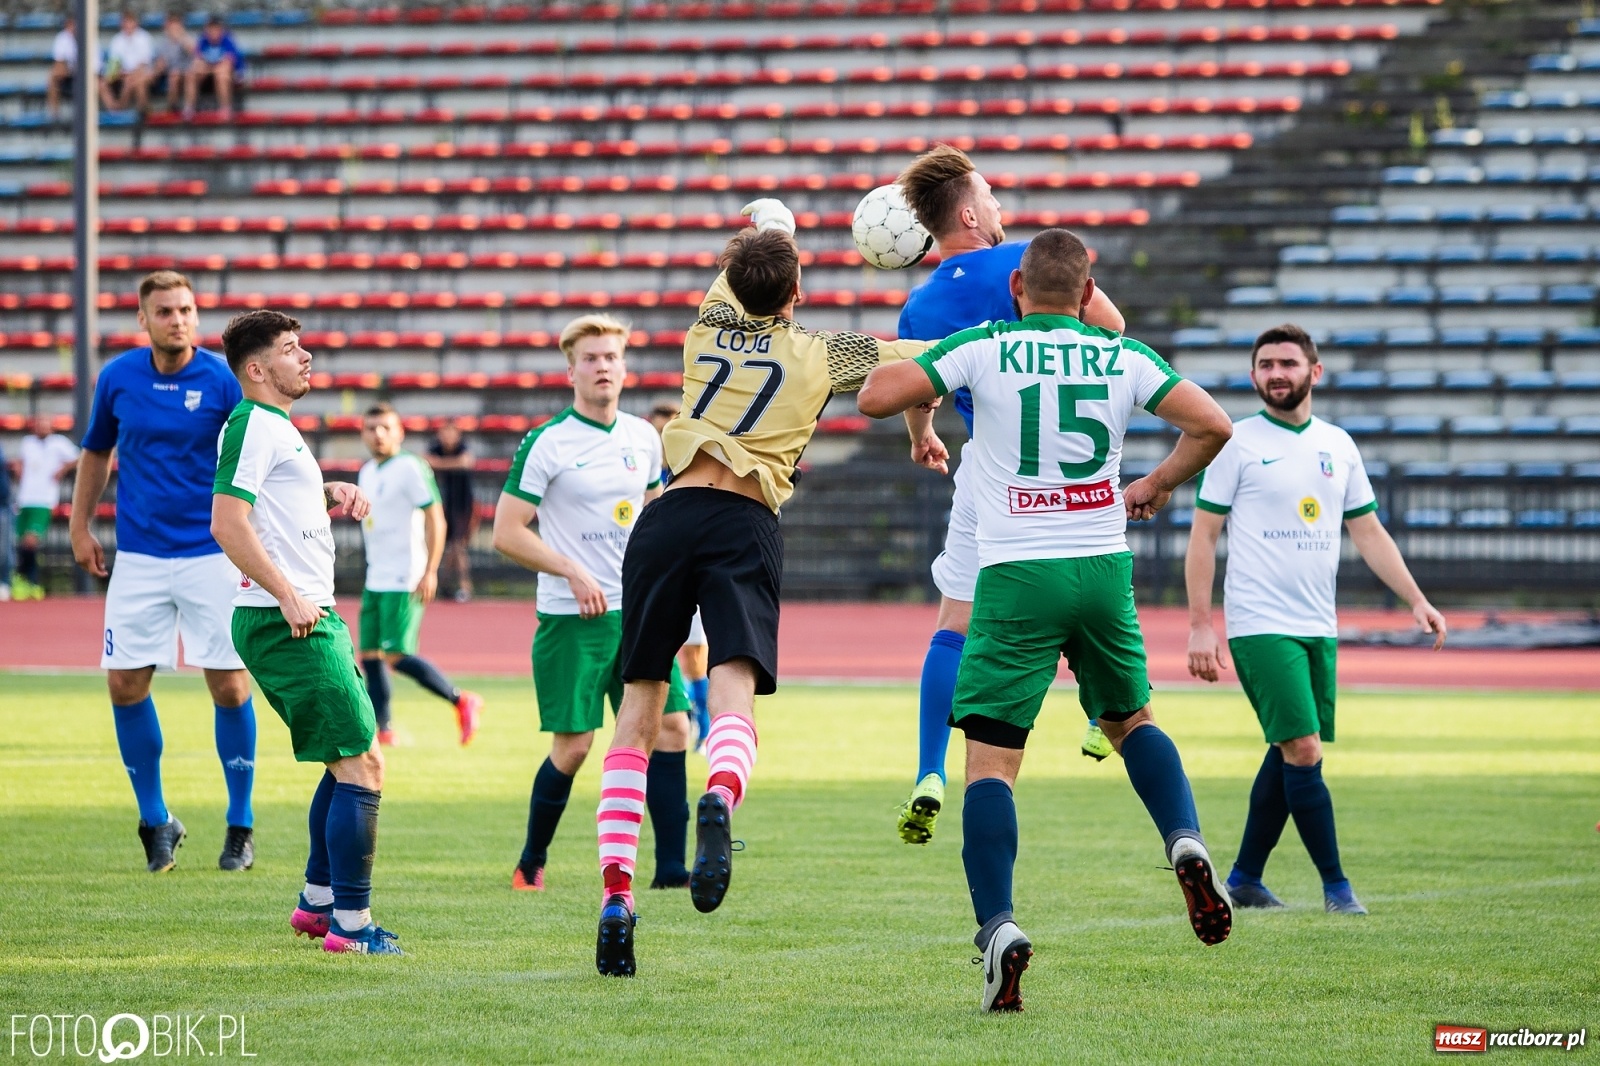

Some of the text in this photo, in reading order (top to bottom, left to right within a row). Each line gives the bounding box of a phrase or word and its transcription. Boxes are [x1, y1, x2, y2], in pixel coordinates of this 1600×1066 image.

[999, 340, 1125, 378] KIETRZ
[689, 353, 787, 437] 77
[1015, 381, 1111, 480] 15
[1263, 530, 1321, 540] KOMBINAT
[1297, 542, 1331, 552] KIETRZ
